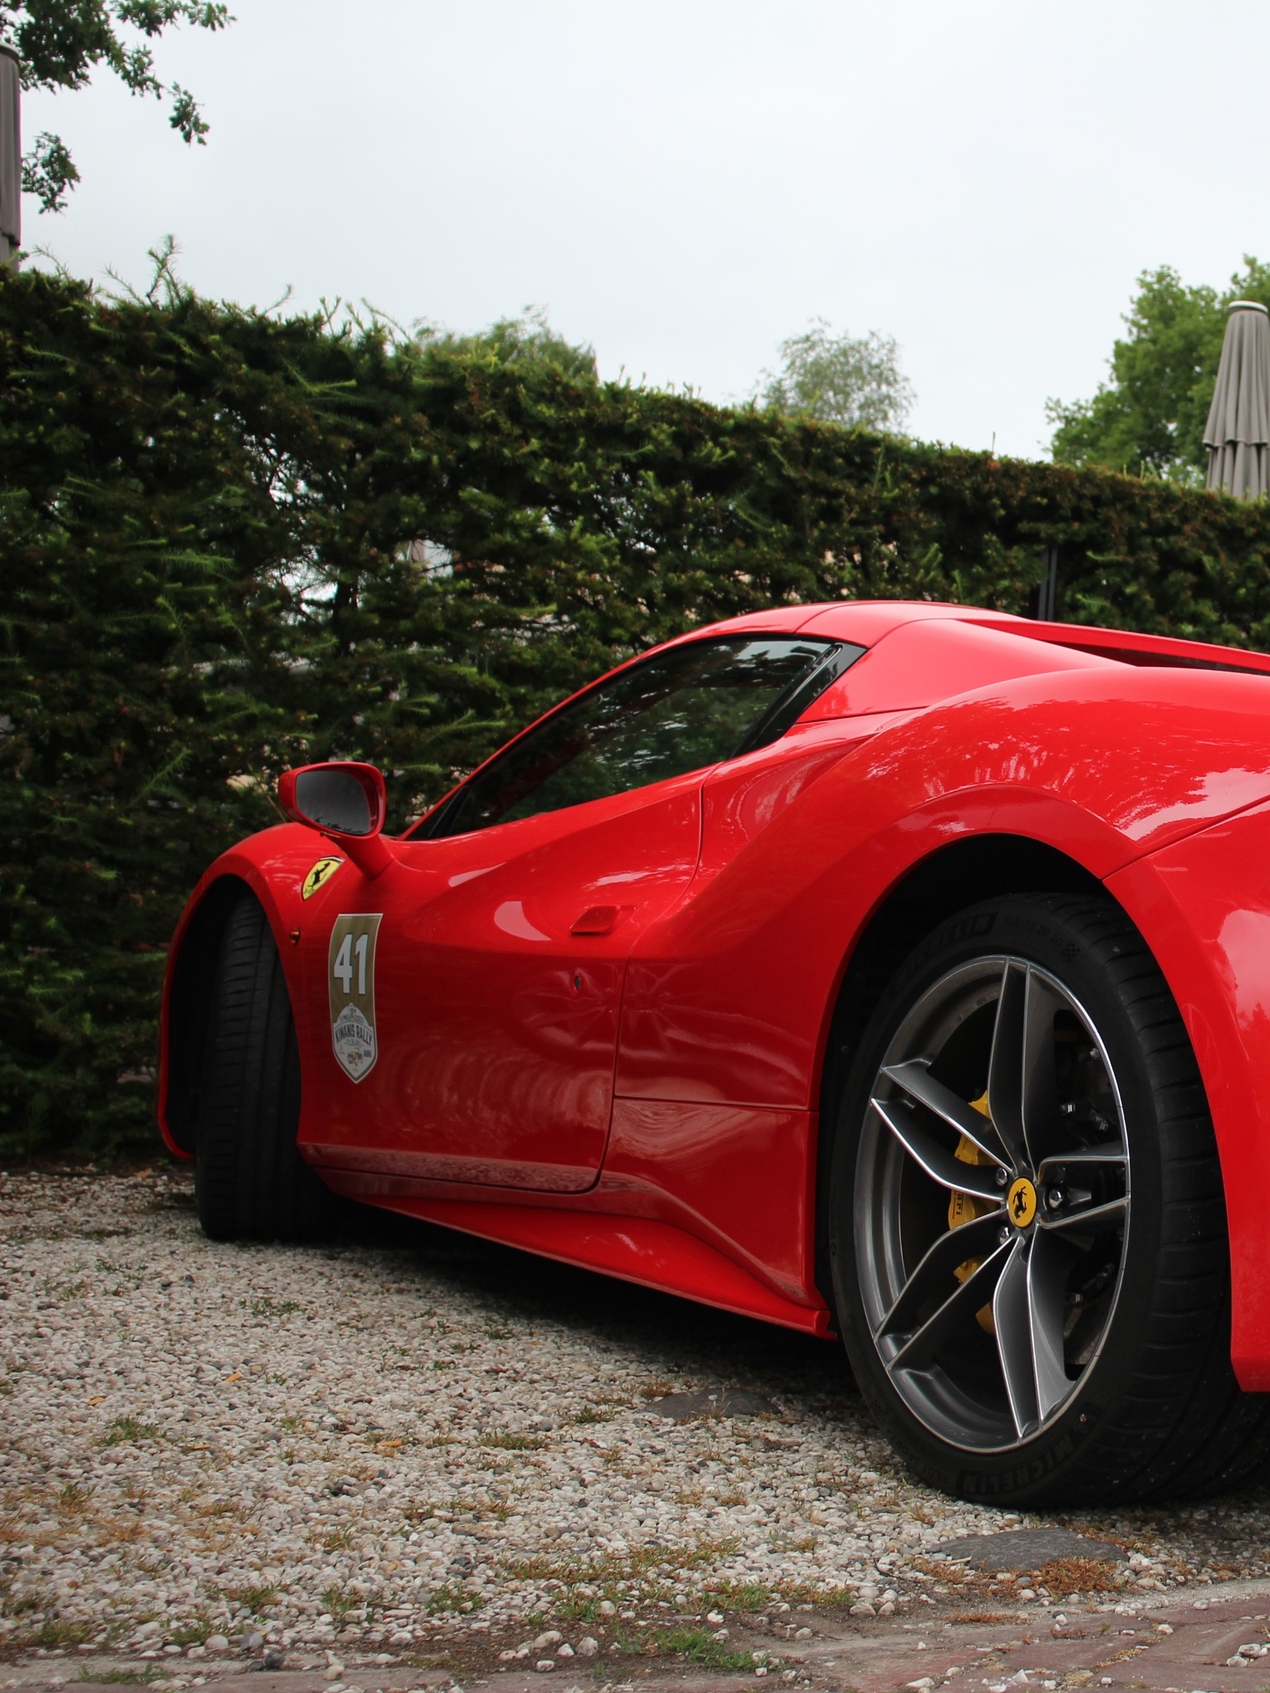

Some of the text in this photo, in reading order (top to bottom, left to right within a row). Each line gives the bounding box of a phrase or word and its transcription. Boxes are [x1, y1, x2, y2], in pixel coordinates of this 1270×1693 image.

[334, 933, 369, 995] 41
[356, 1025, 373, 1046] RALLY
[962, 1431, 1074, 1494] MICHELIN
